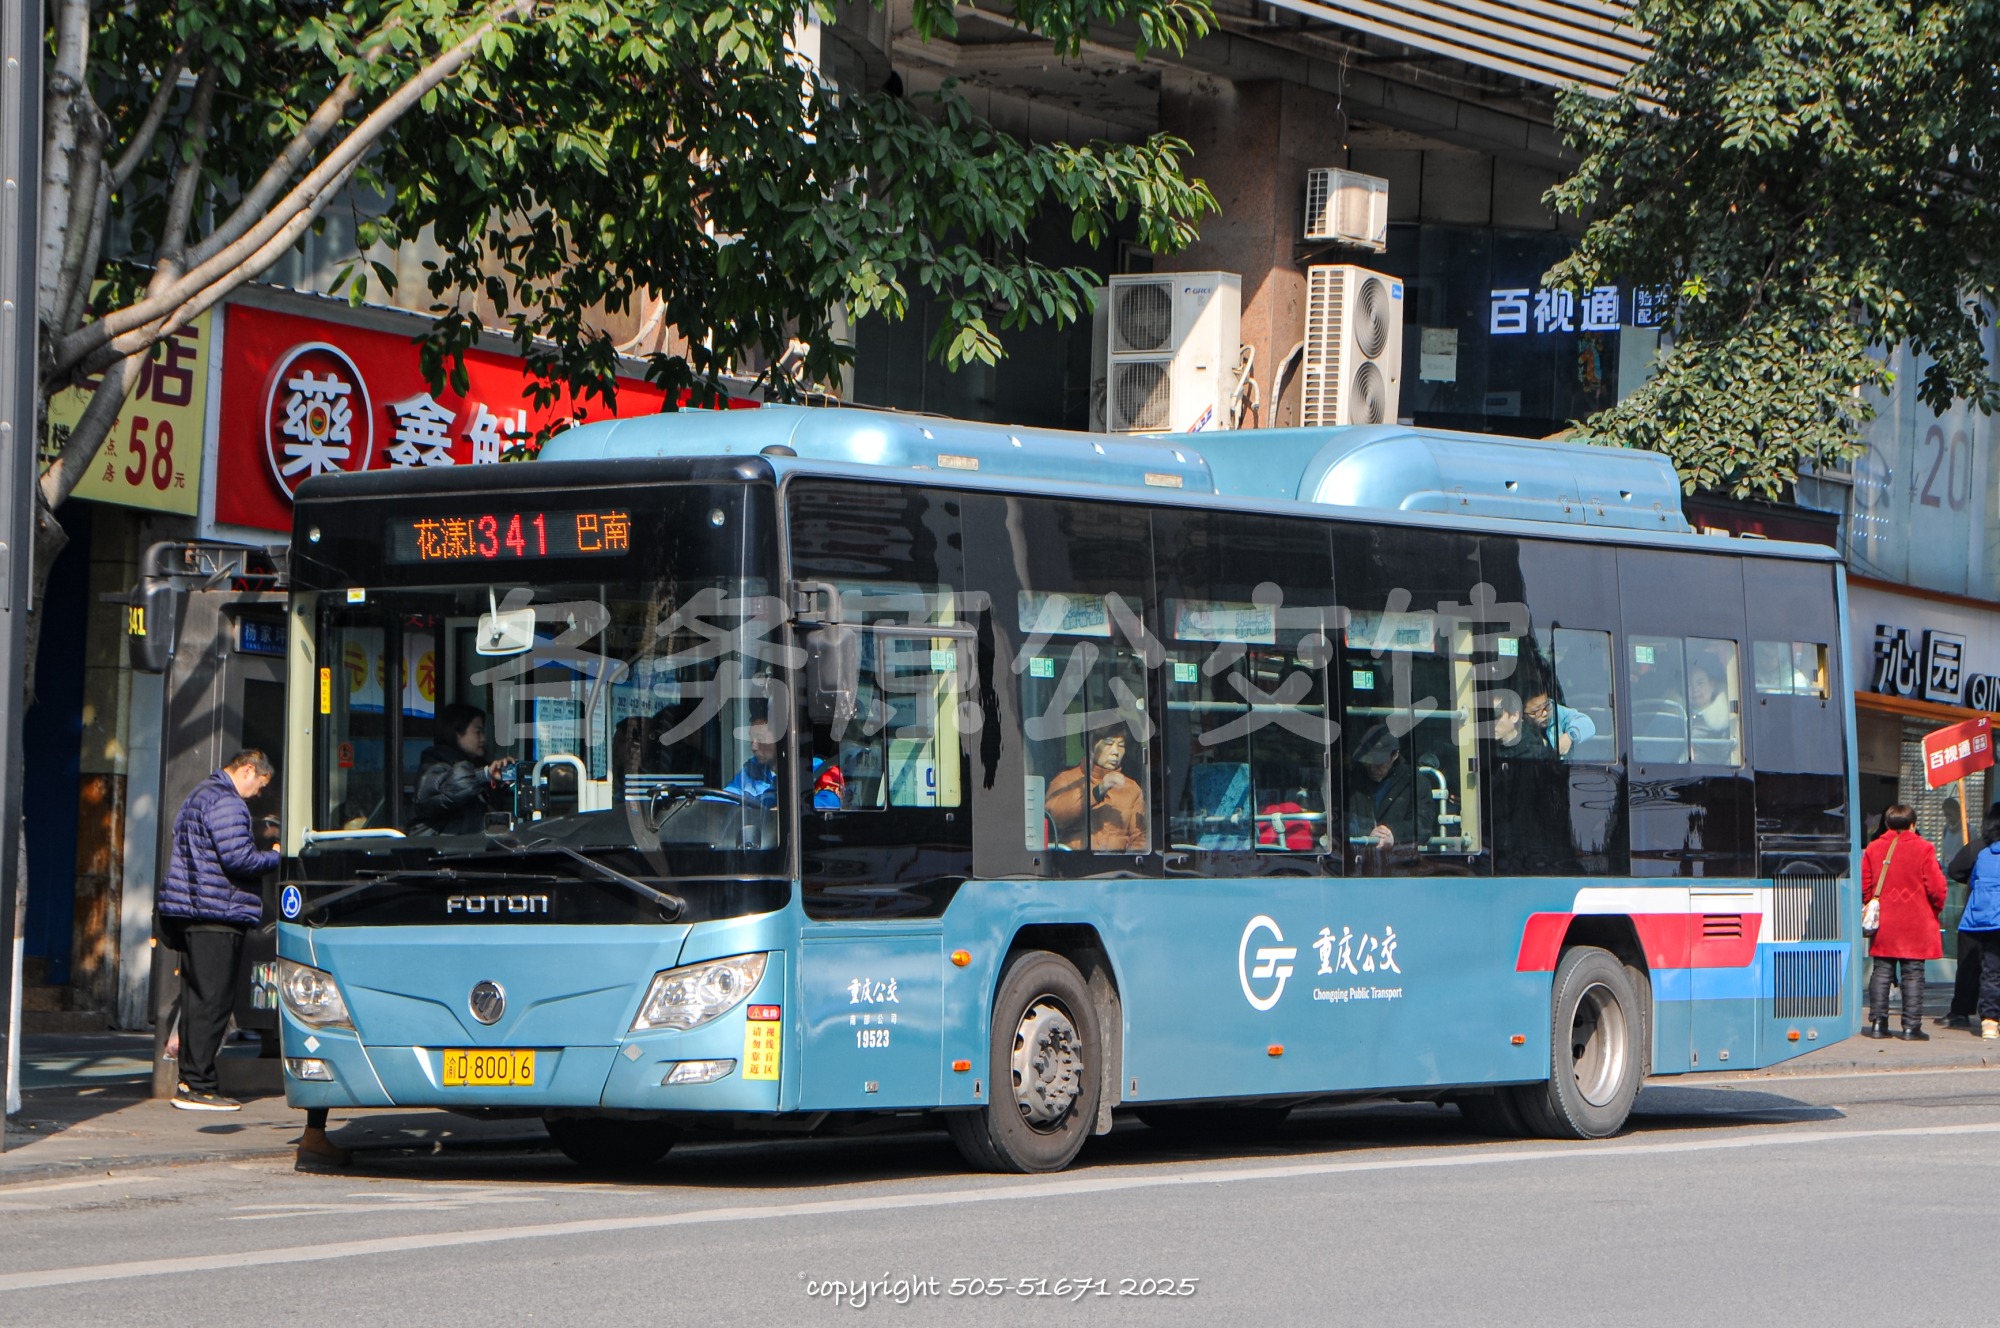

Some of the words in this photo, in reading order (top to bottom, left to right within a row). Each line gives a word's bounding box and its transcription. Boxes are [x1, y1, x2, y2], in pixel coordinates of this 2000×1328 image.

[1491, 286, 1620, 334] 百视通
[478, 514, 547, 557] 341
[576, 511, 629, 550] 巴南
[1871, 624, 1966, 704] 沁园
[1930, 740, 1971, 769] 百视通
[447, 895, 548, 913] FOTON
[1312, 926, 1402, 976] 重庆公交
[847, 977, 900, 1004] 重庆公交
[1313, 988, 1349, 1003] Chongqing
[1349, 987, 1369, 999] Public
[1370, 986, 1402, 1001] Transport
[762, 1008, 778, 1018] 危险
[856, 1029, 890, 1048] 19523
